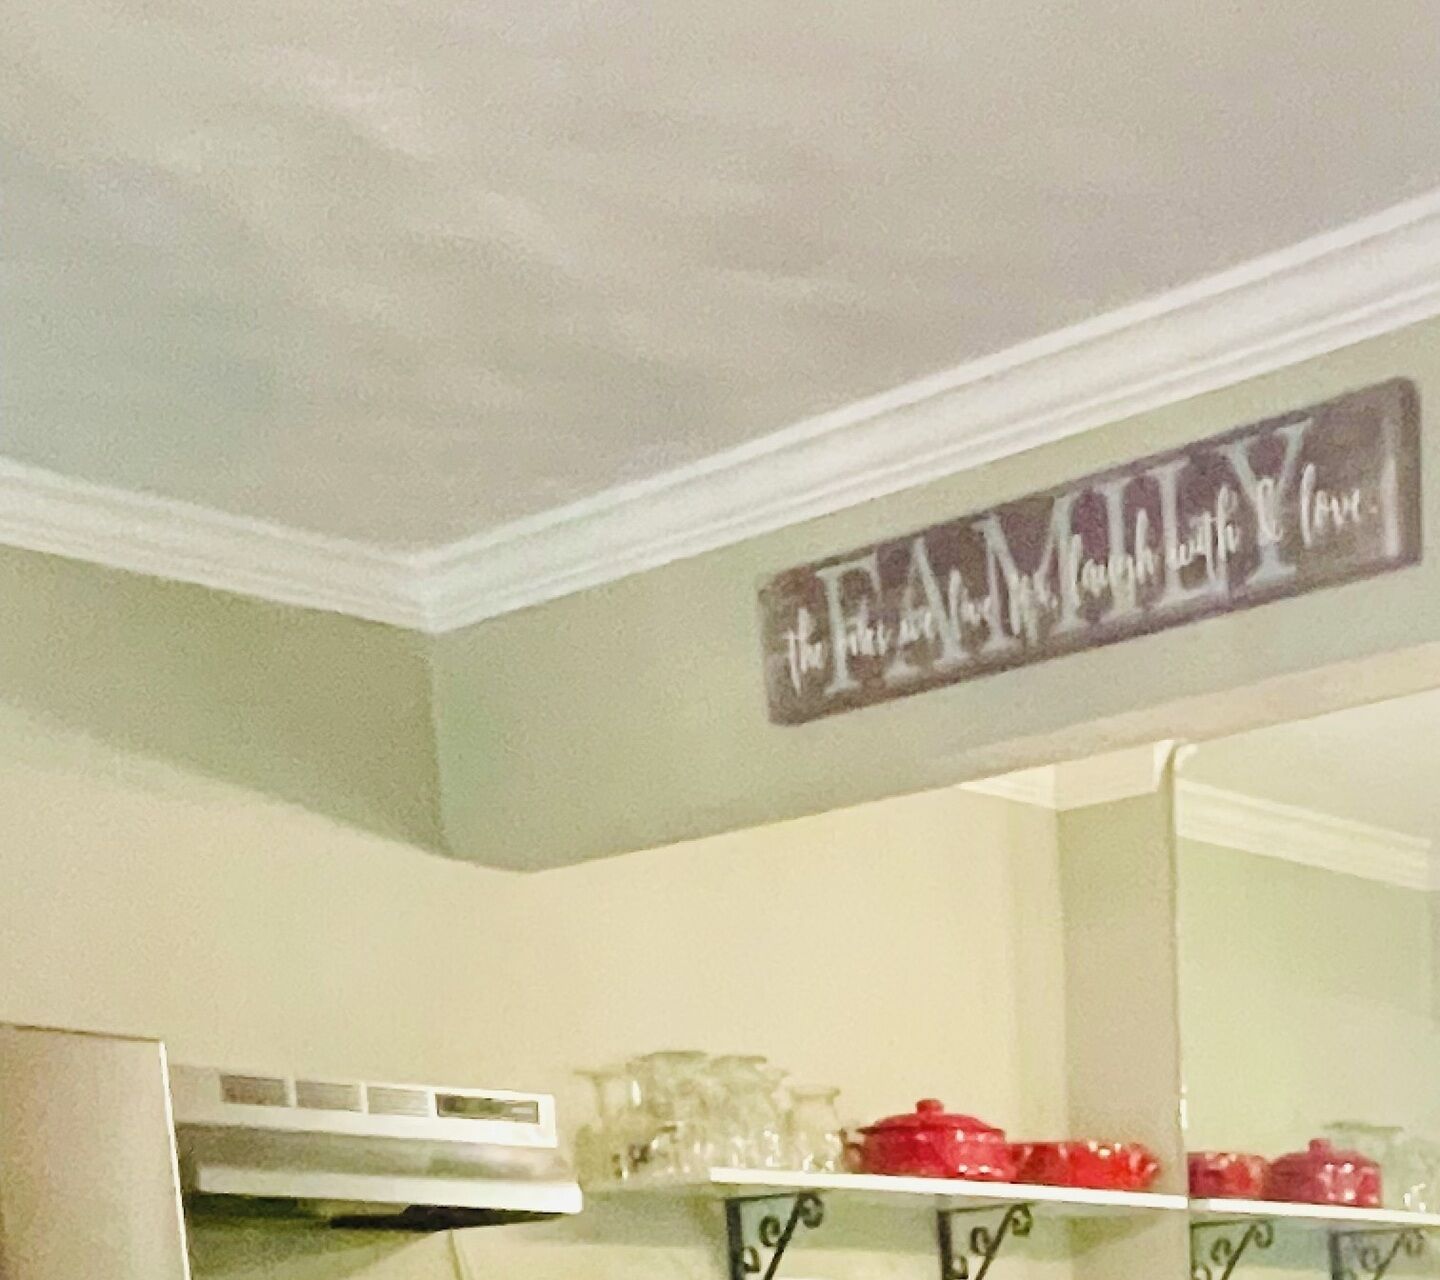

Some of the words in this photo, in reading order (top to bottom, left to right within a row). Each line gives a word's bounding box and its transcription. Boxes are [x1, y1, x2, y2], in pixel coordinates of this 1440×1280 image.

[816, 417, 1313, 697] FAMILY
[1066, 507, 1160, 611] laugh
[1170, 484, 1242, 590] with
